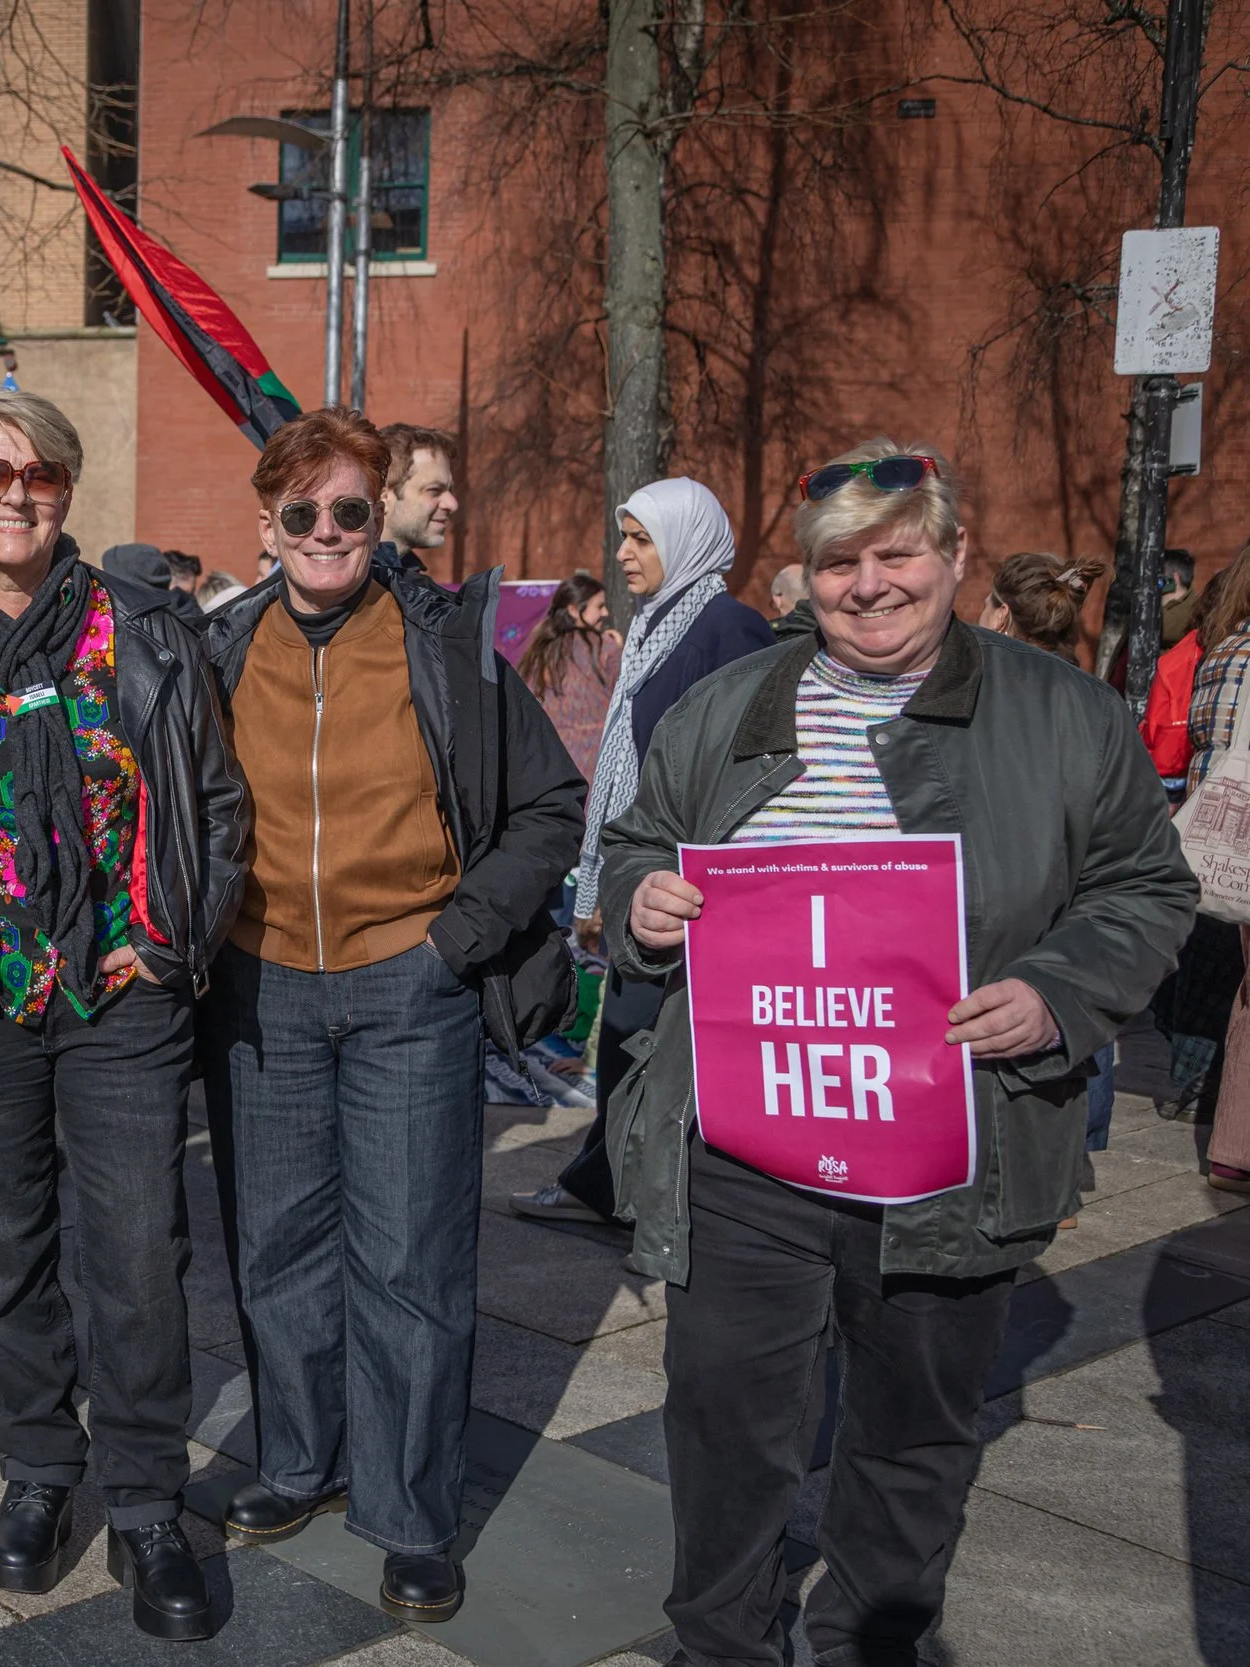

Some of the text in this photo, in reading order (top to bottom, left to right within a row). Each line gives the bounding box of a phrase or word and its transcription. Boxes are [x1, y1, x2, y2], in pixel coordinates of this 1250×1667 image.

[25, 683, 44, 693] BOYCOTT
[706, 860, 929, 876] We stand with victims & survivors of abuse
[811, 895, 826, 968] I
[751, 985, 896, 1028] BELIEVE
[760, 1041, 896, 1121] HER
[818, 1156, 848, 1175] ROSA
